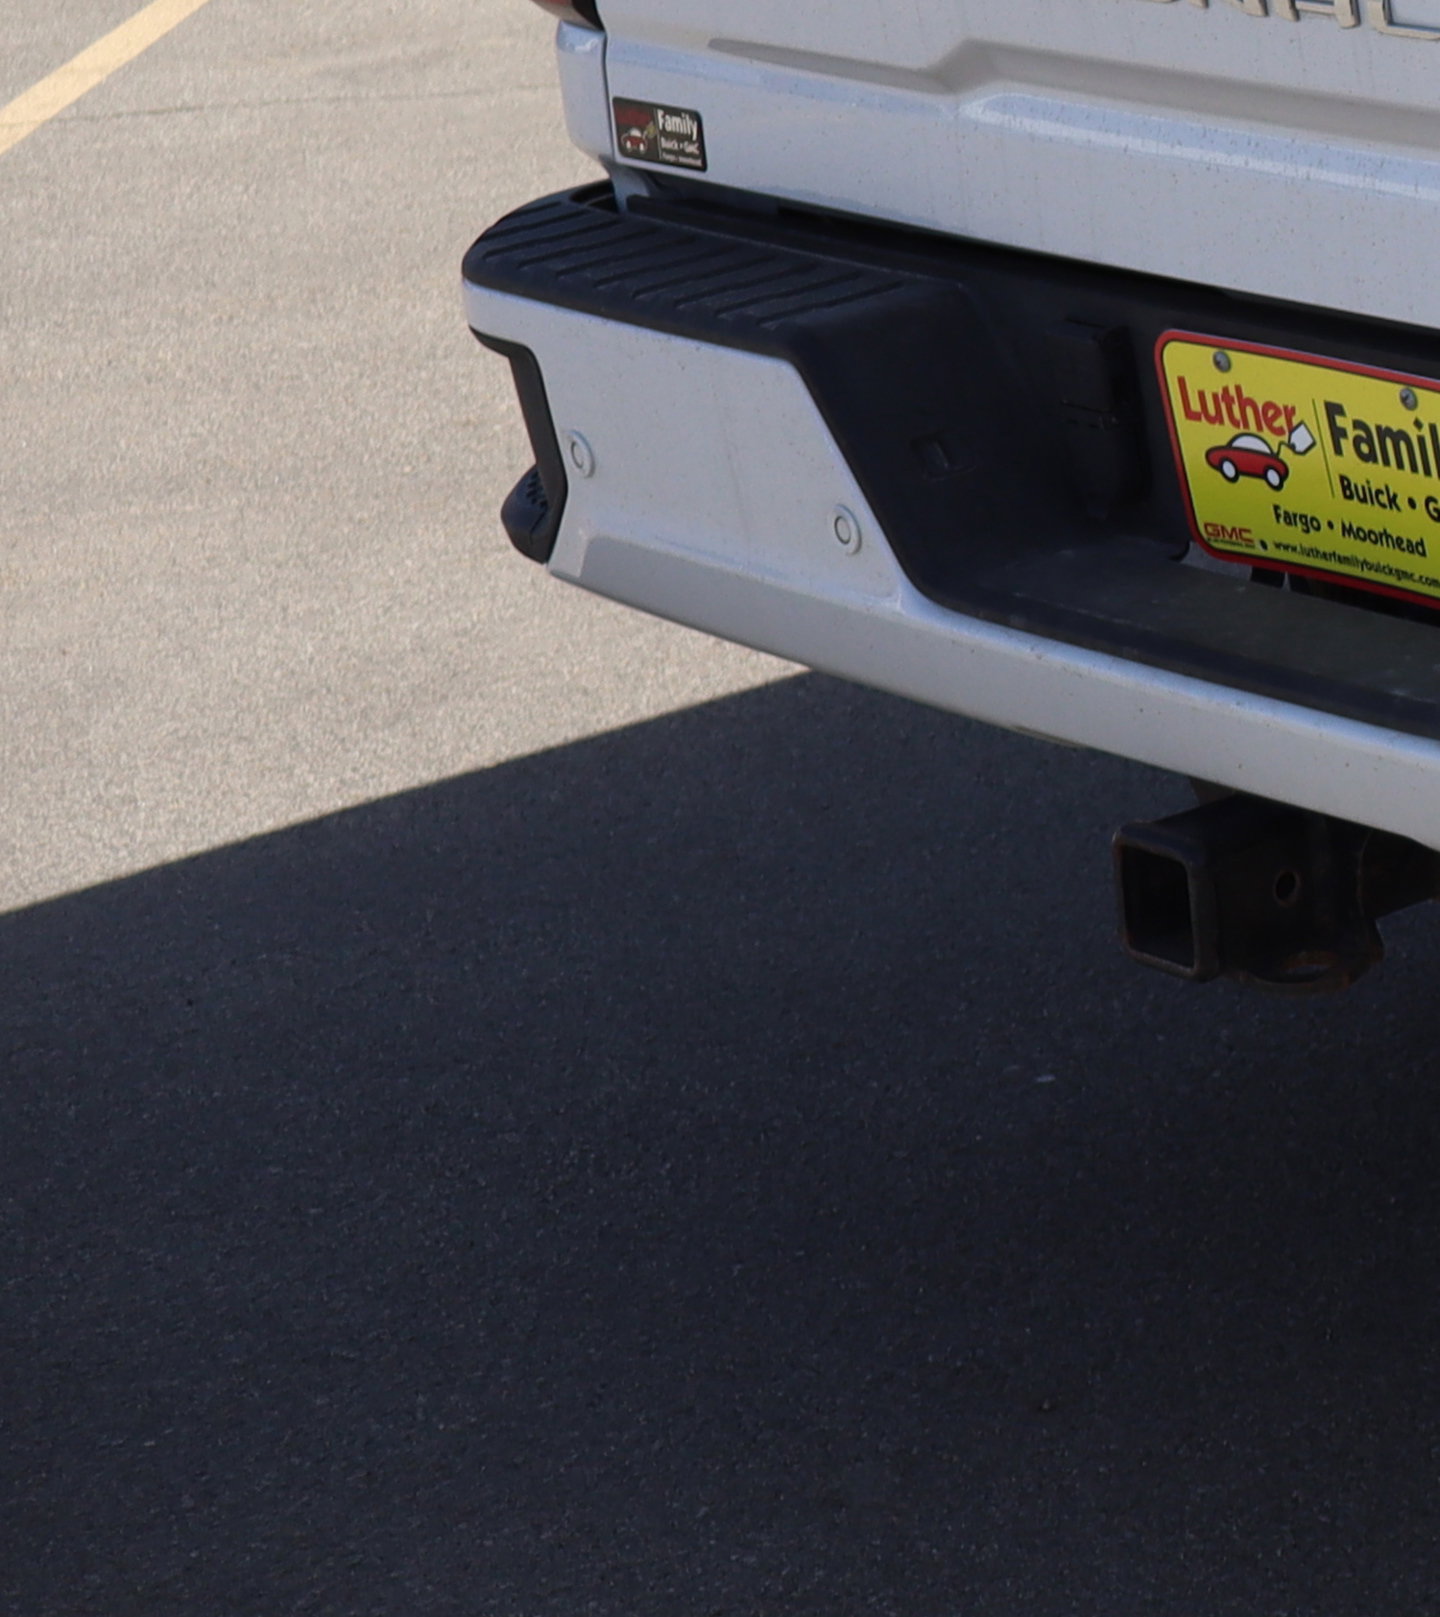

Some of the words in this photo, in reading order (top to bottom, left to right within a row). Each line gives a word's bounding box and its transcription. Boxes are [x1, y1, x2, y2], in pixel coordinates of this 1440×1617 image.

[657, 108, 698, 141] Family
[1177, 375, 1296, 437] Luther
[1339, 473, 1402, 513] Buick
[1203, 522, 1254, 544] GMC
[1272, 504, 1321, 535] Fargo
[1341, 519, 1428, 559] Moorhead
